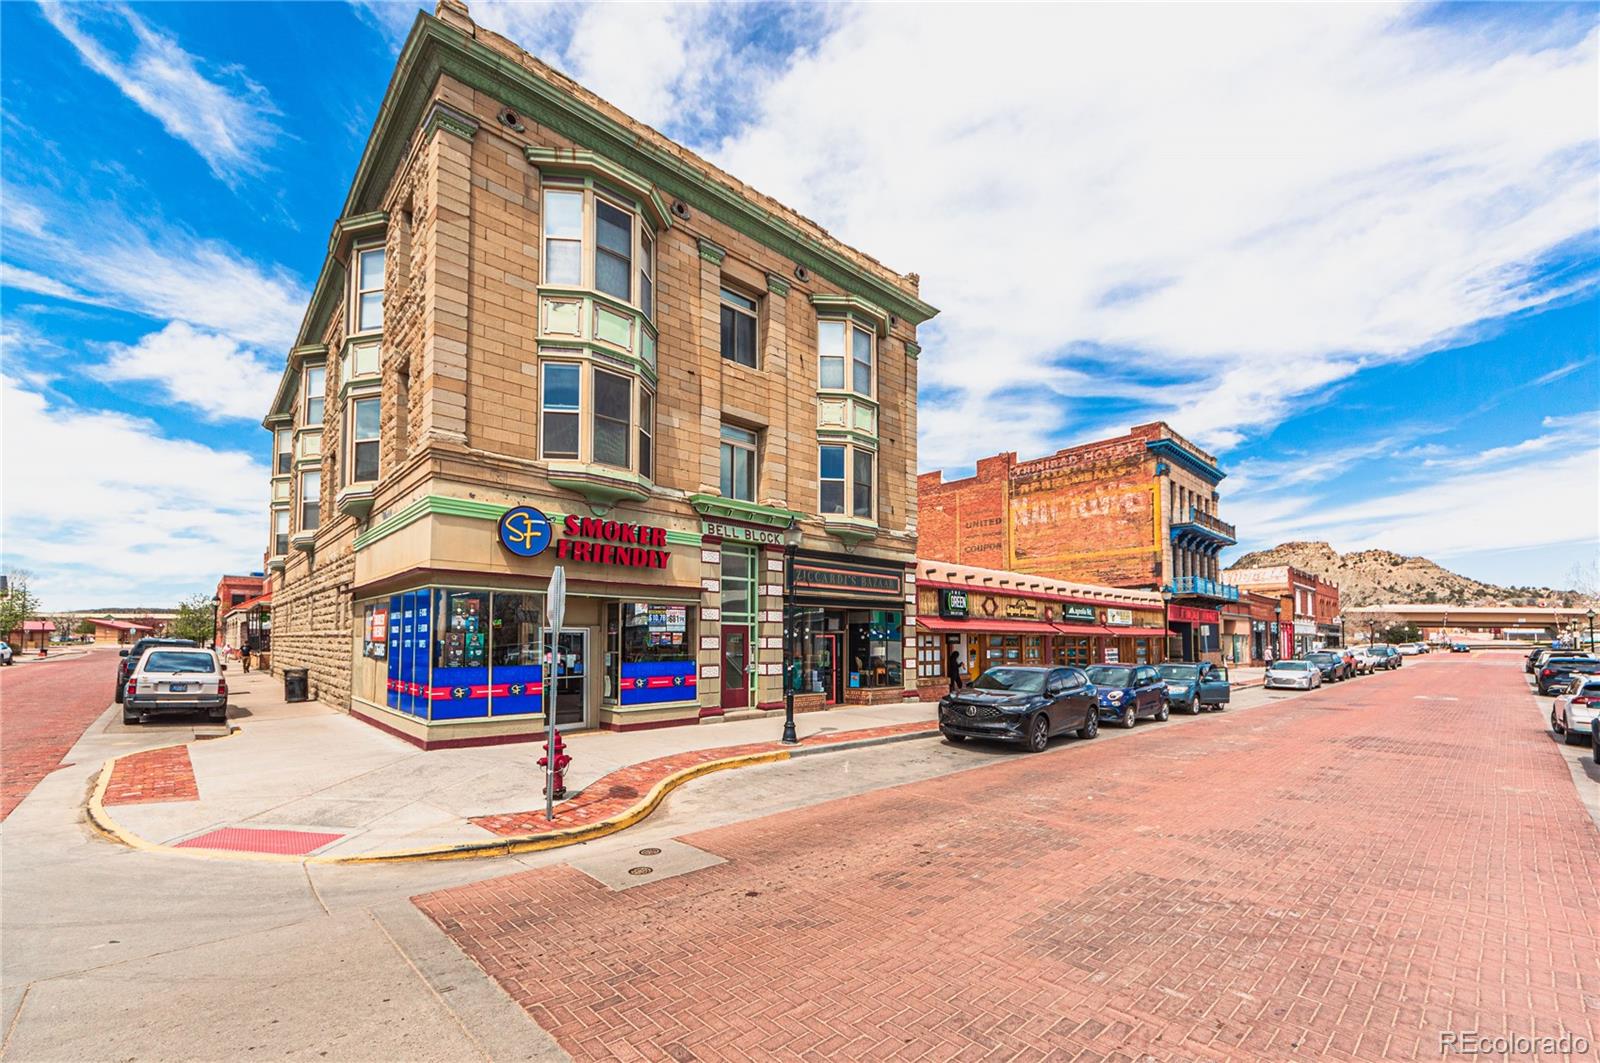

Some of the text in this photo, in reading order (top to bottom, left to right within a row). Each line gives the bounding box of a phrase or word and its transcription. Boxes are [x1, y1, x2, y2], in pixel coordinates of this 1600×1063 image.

[505, 512, 547, 549] SF
[563, 514, 668, 547] SMOKER
[707, 523, 781, 545] BELL BLOCK
[965, 517, 1003, 529] UNITED
[557, 539, 671, 569] FRIENDLY
[964, 542, 1003, 554] COUPON
[795, 569, 857, 586] ZICCARDI'S
